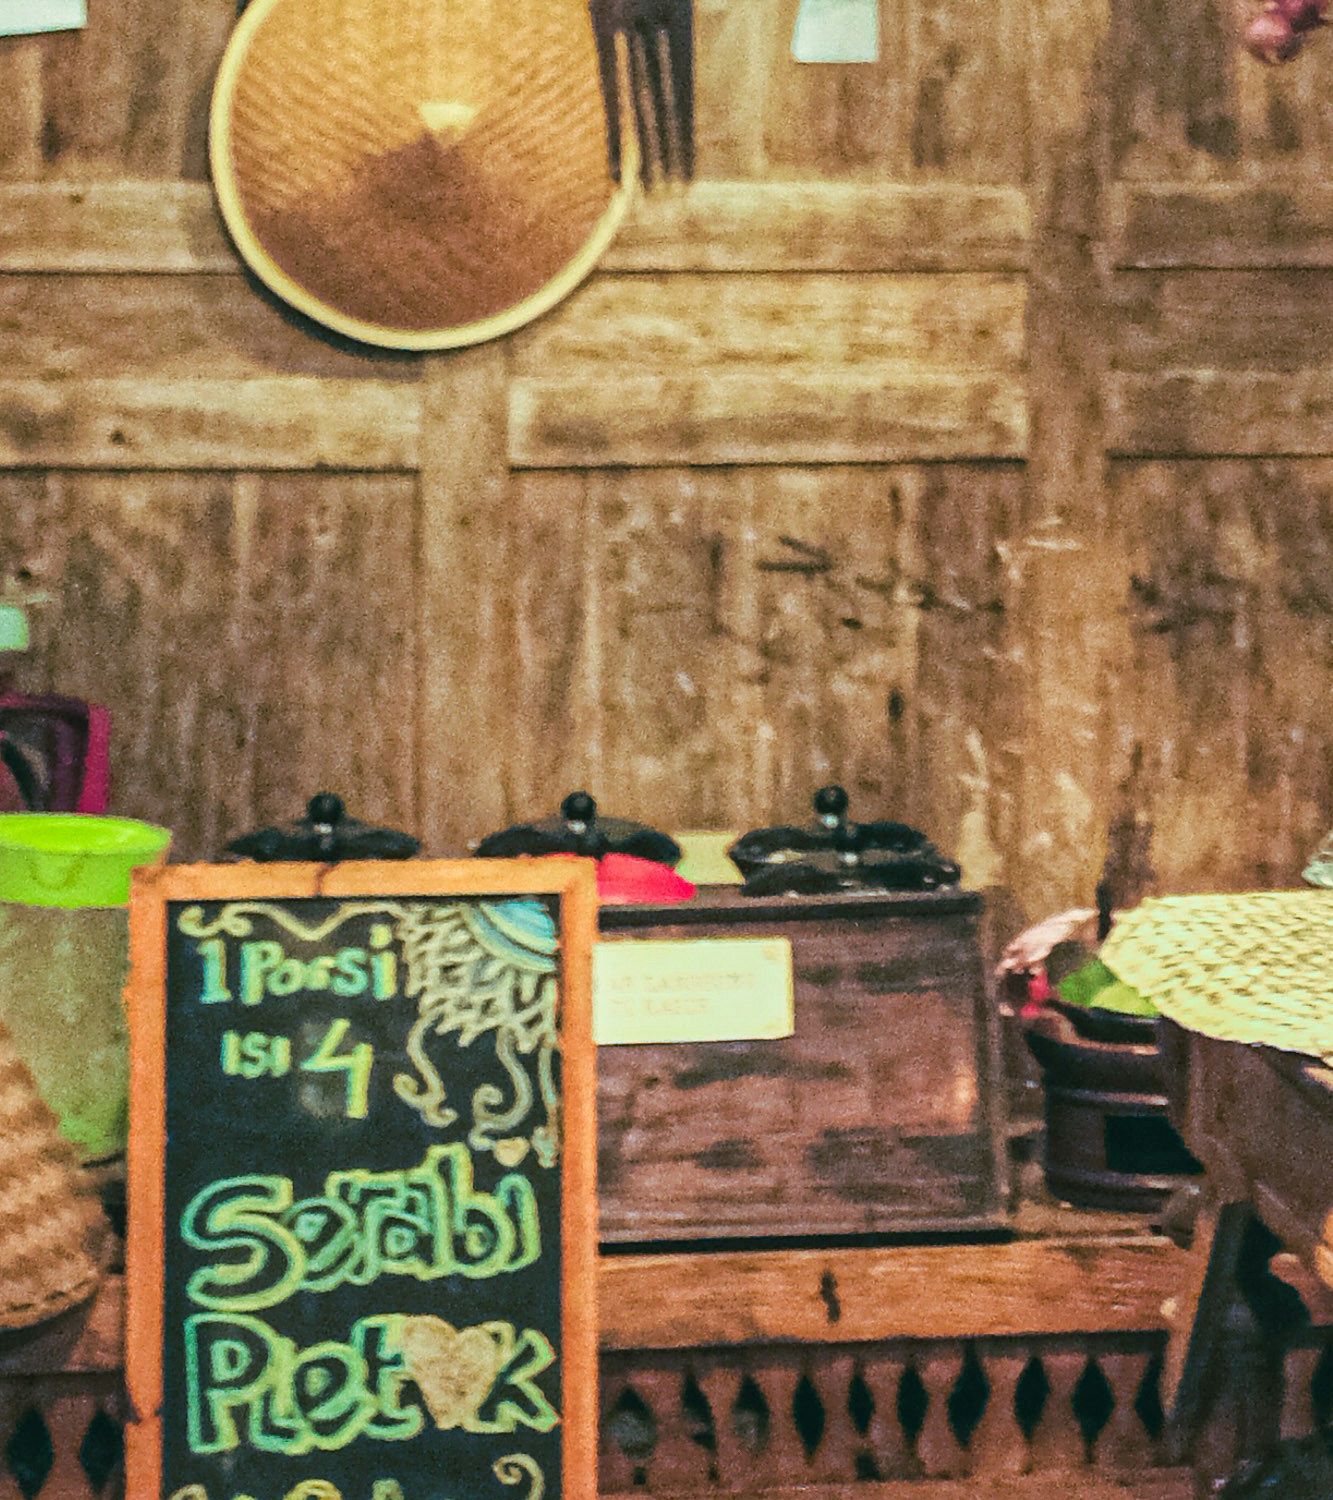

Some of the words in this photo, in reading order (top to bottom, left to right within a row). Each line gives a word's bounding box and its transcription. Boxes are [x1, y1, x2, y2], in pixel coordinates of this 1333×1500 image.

[197, 938, 232, 1004] 1
[240, 923, 397, 1006] Porsi
[301, 1017, 373, 1118] 4
